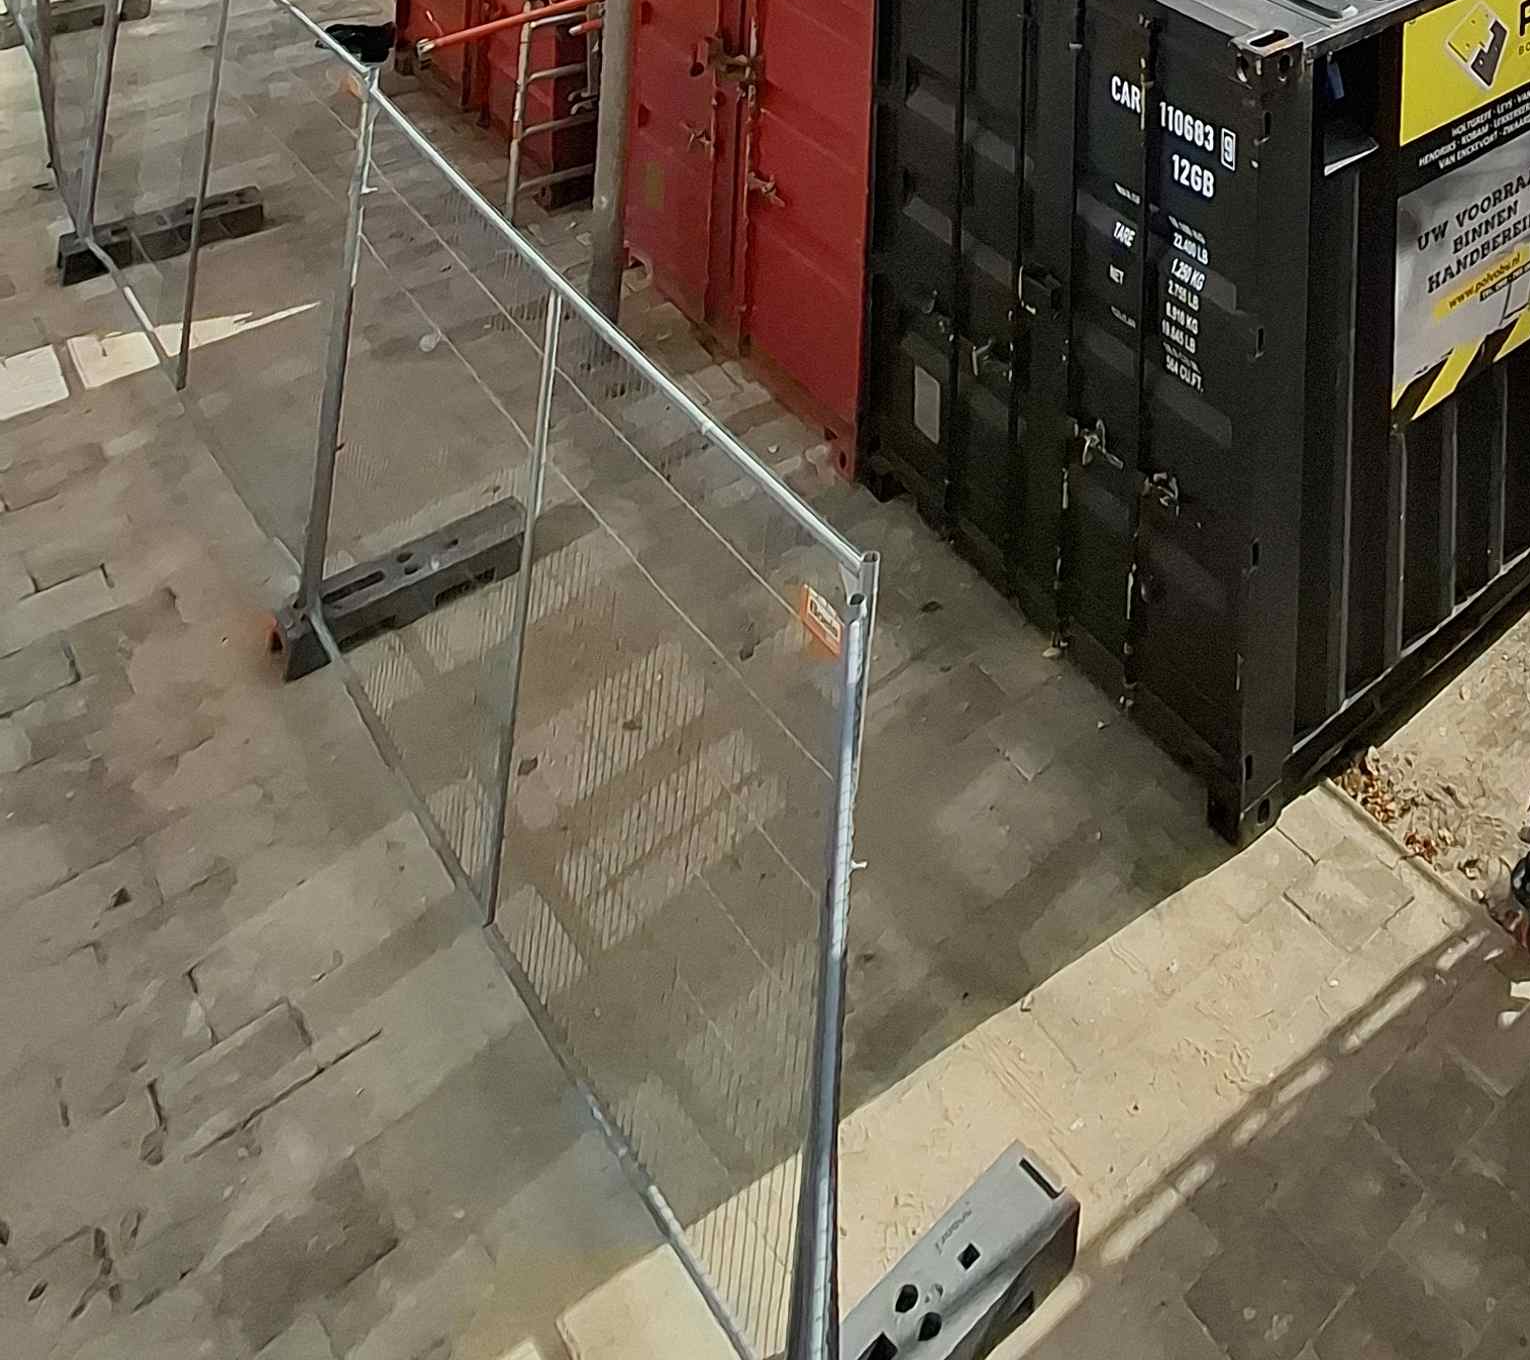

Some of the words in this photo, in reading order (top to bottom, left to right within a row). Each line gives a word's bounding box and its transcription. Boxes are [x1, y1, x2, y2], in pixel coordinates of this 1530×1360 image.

[1159, 101, 1215, 152] 110683
[1171, 153, 1215, 198] 12GB
[1417, 220, 1449, 251] UW
[1452, 199, 1519, 254] BINNEN
